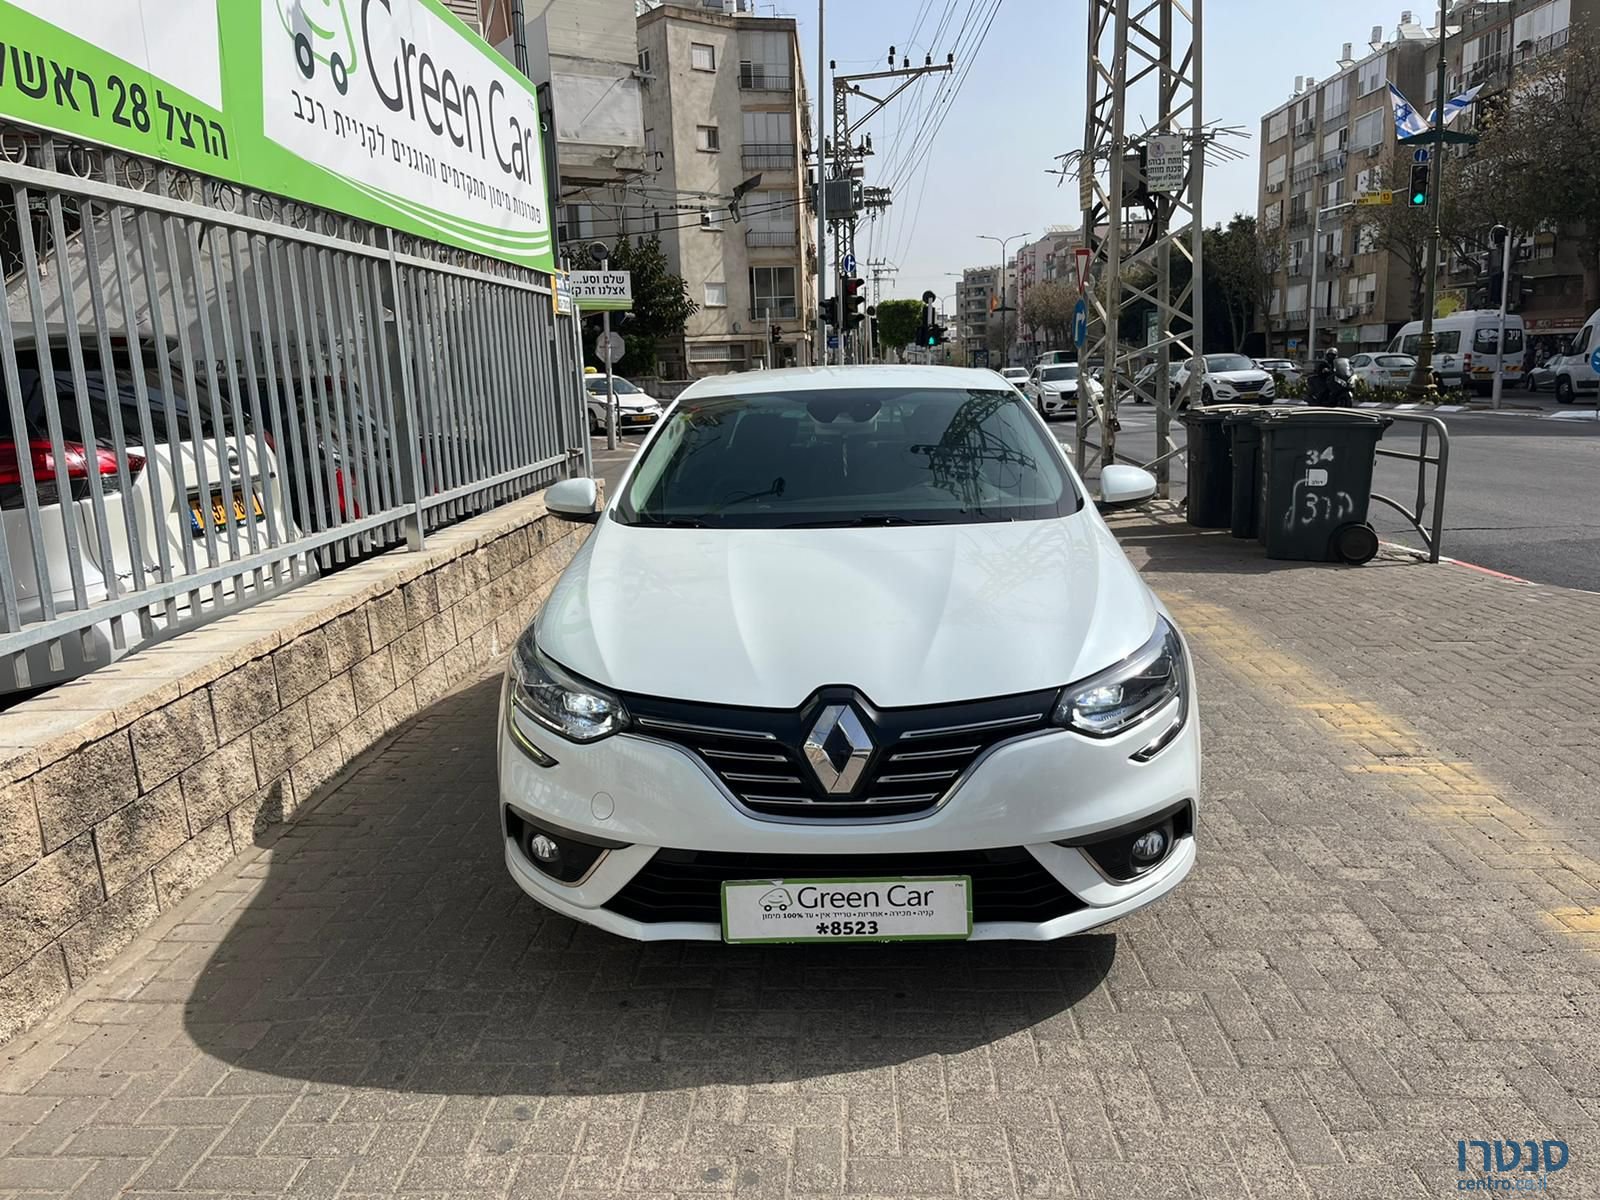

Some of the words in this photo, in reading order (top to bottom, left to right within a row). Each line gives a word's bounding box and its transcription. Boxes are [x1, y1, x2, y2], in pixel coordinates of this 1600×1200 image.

[107, 74, 151, 133] 28
[361, 0, 485, 160] Green
[488, 79, 533, 186] Car
[291, 89, 328, 130] רכב
[156, 89, 229, 160] הרצל
[333, 109, 385, 159] לקניית
[391, 138, 437, 179] והוגנים
[440, 162, 487, 200] מתקדמים
[489, 185, 511, 210] מימון
[513, 197, 542, 224] פתרונות
[573, 275, 600, 284] וסע...
[585, 286, 596, 295] זה
[598, 285, 625, 296] אצלנו
[602, 274, 625, 284] שלם
[1305, 446, 1335, 465] 34
[797, 886, 880, 909] Green
[887, 884, 934, 908] Car
[820, 912, 831, 920] אין
[917, 910, 935, 918] קניה
